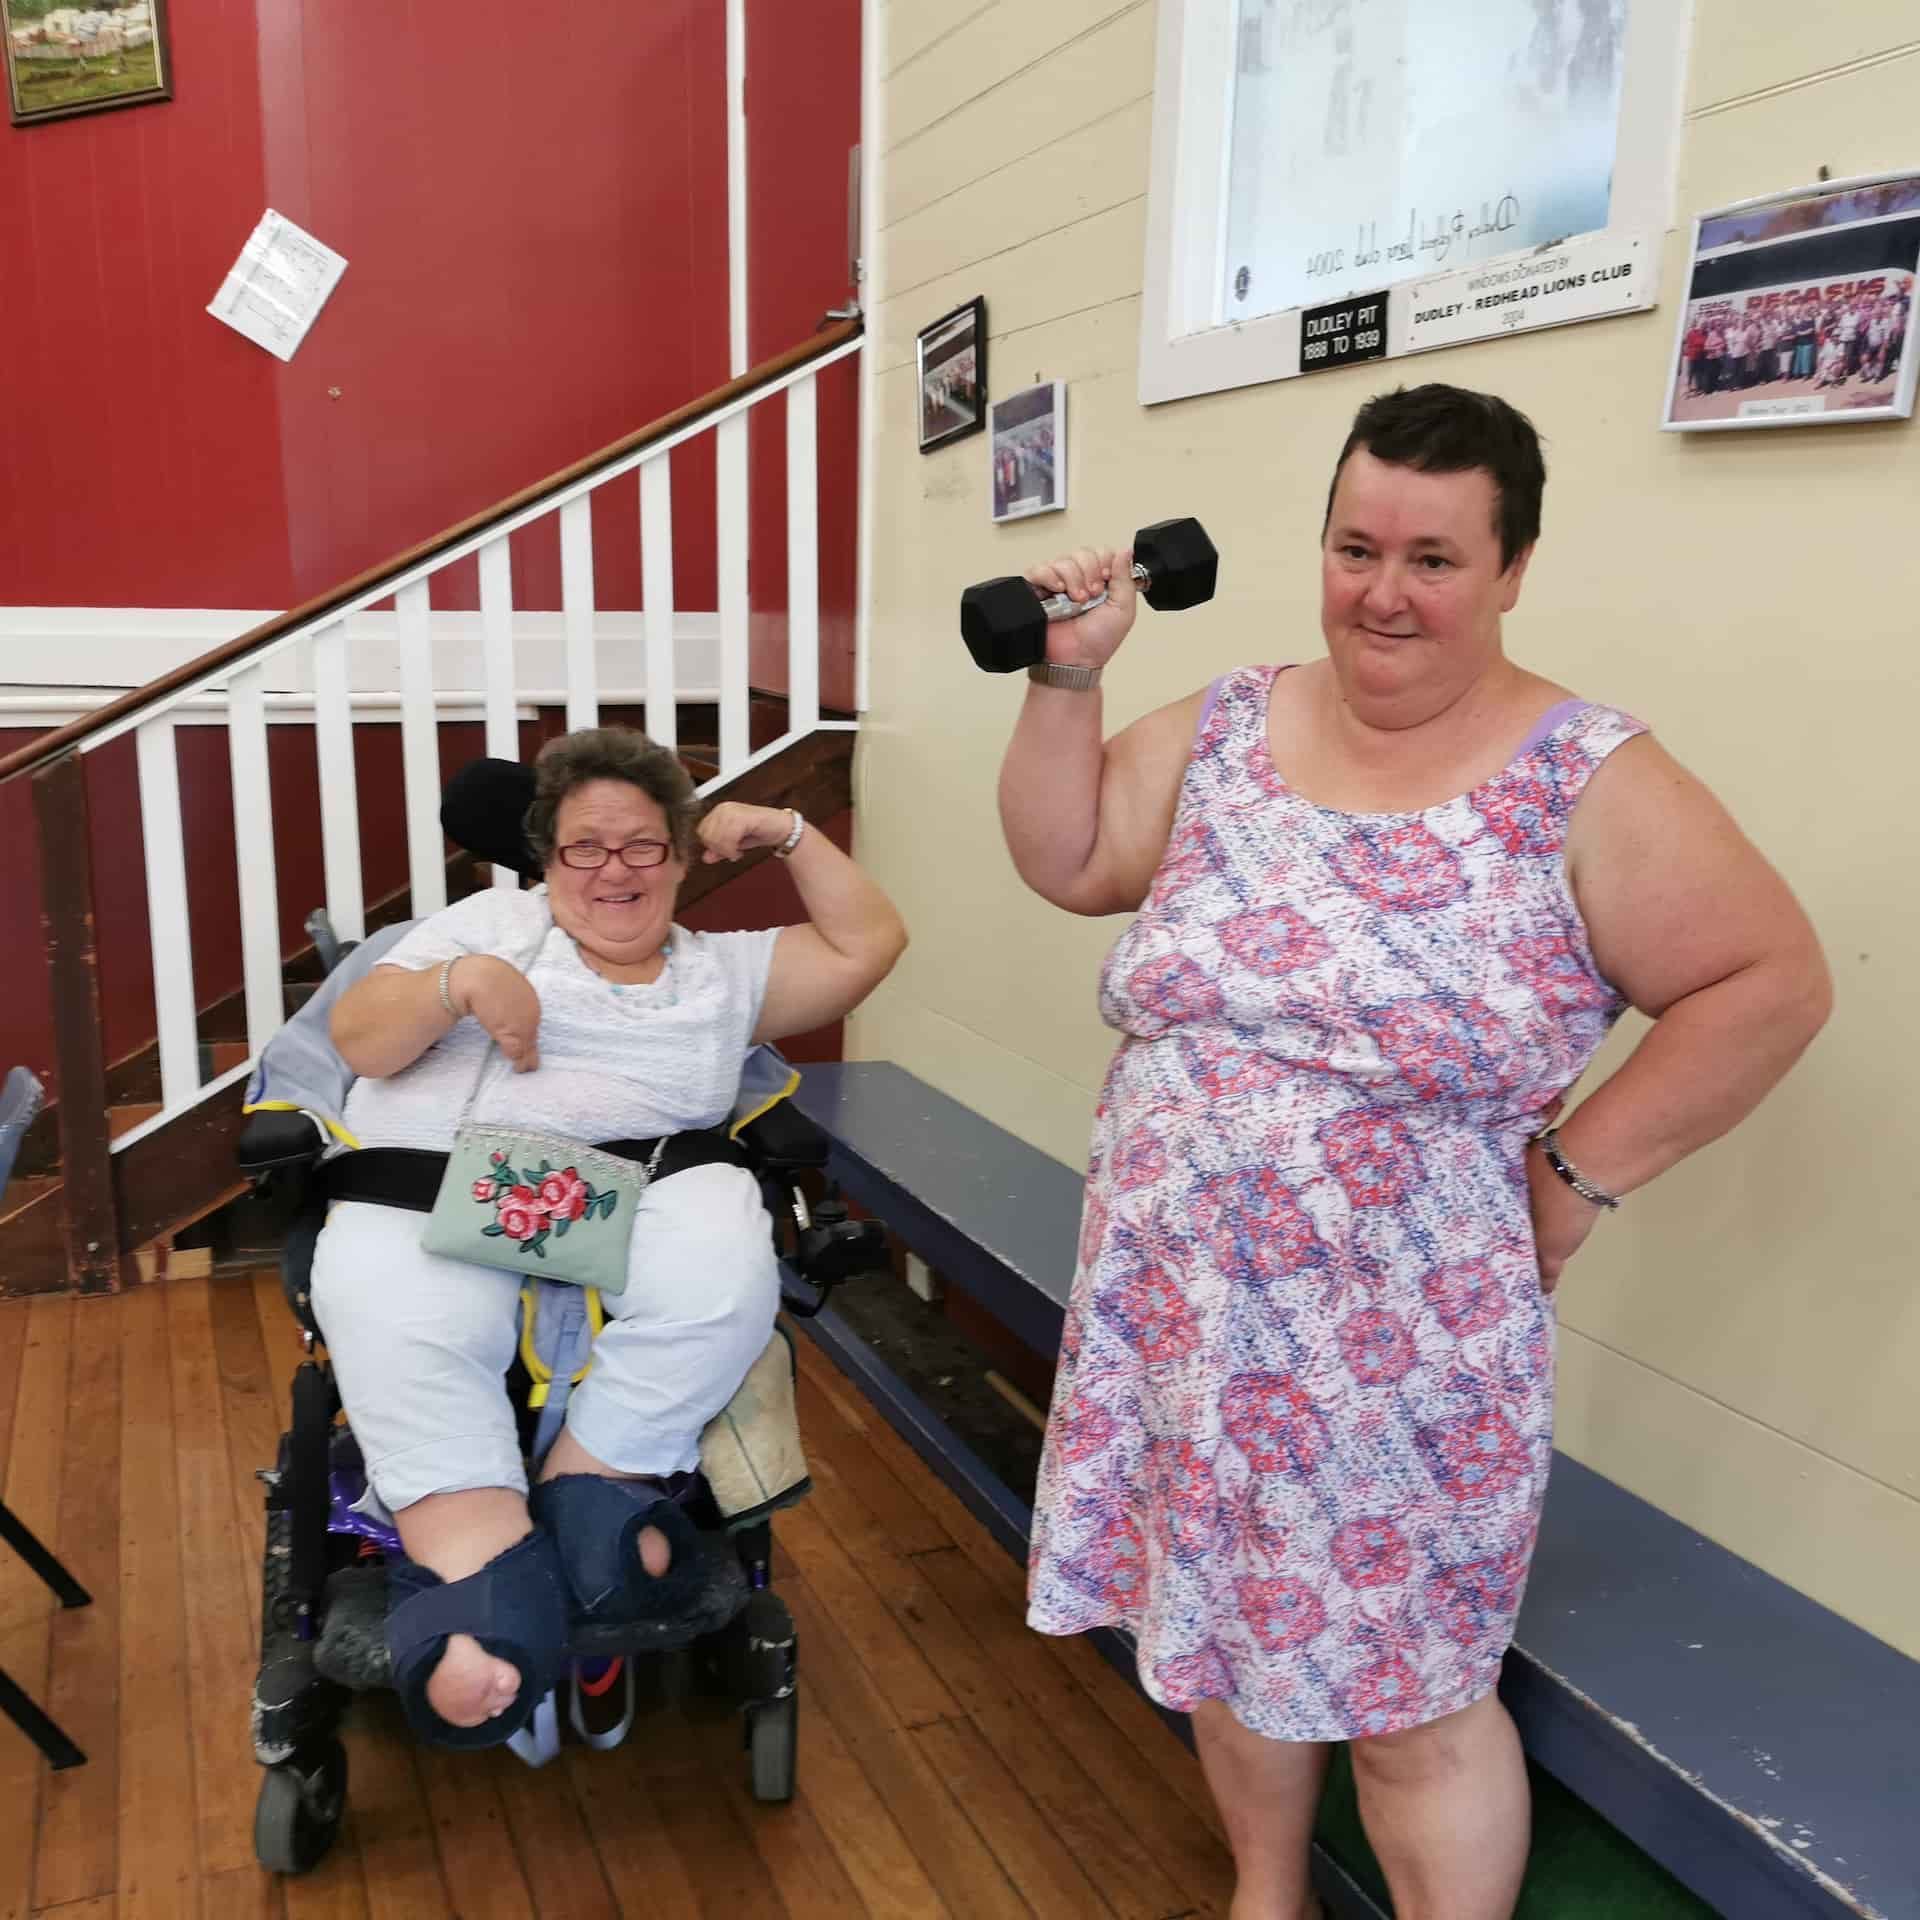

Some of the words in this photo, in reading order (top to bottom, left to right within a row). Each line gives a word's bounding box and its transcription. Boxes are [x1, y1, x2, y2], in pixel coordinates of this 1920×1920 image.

[1413, 303, 1463, 325] DUDLEY
[1474, 285, 1539, 311] REDHEAD
[1542, 274, 1587, 296] LIONS
[1590, 262, 1633, 284] CLUB
[1306, 310, 1354, 338] DUDLEY
[1357, 304, 1380, 327] PIT
[1332, 335, 1350, 355] TO
